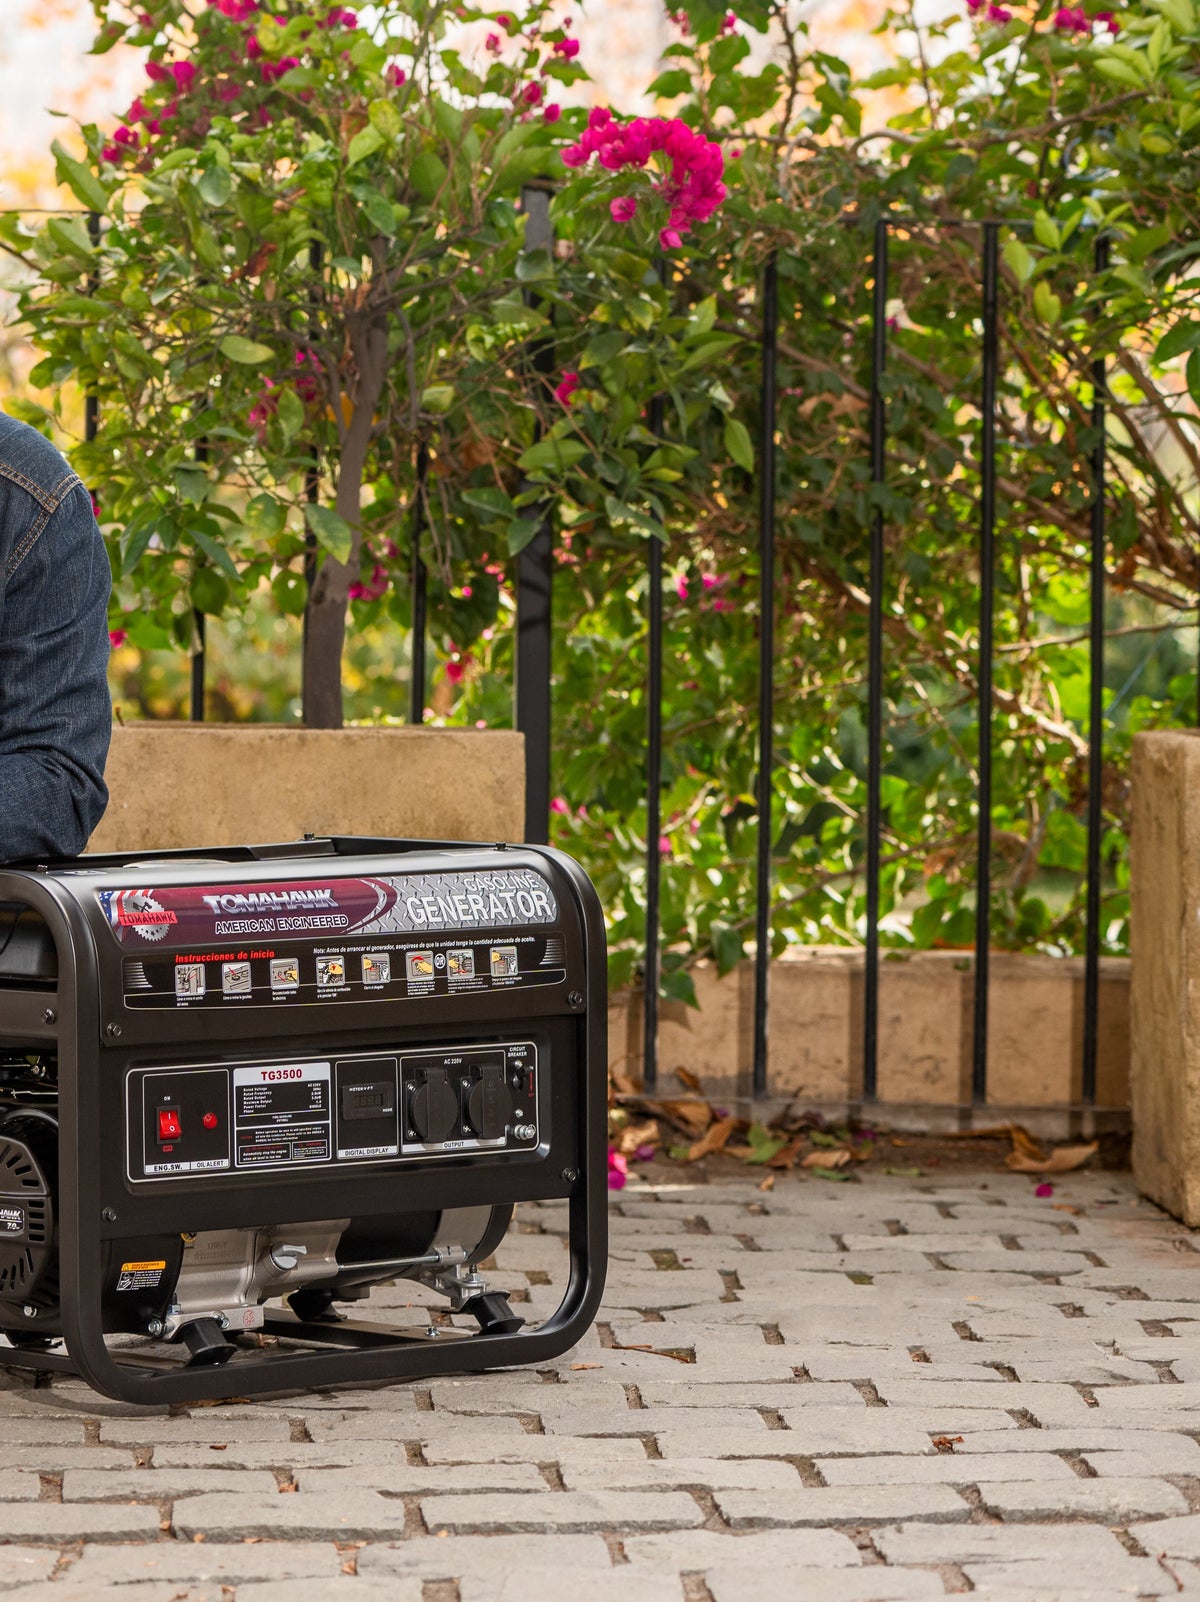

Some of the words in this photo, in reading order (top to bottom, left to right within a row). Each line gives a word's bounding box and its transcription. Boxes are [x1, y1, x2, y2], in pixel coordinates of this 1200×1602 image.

[463, 874, 539, 892] GASOLINE
[202, 888, 339, 915] TOMAHAWK
[406, 890, 553, 925] GENERATOR
[120, 913, 174, 925] TOMAHAWK
[215, 918, 275, 935] AMERICAN
[277, 914, 349, 931] ENGINEERED
[175, 952, 235, 963] Instrucciones
[237, 951, 248, 960] de
[250, 949, 275, 960] inicio
[260, 1068, 302, 1081] TG3500
